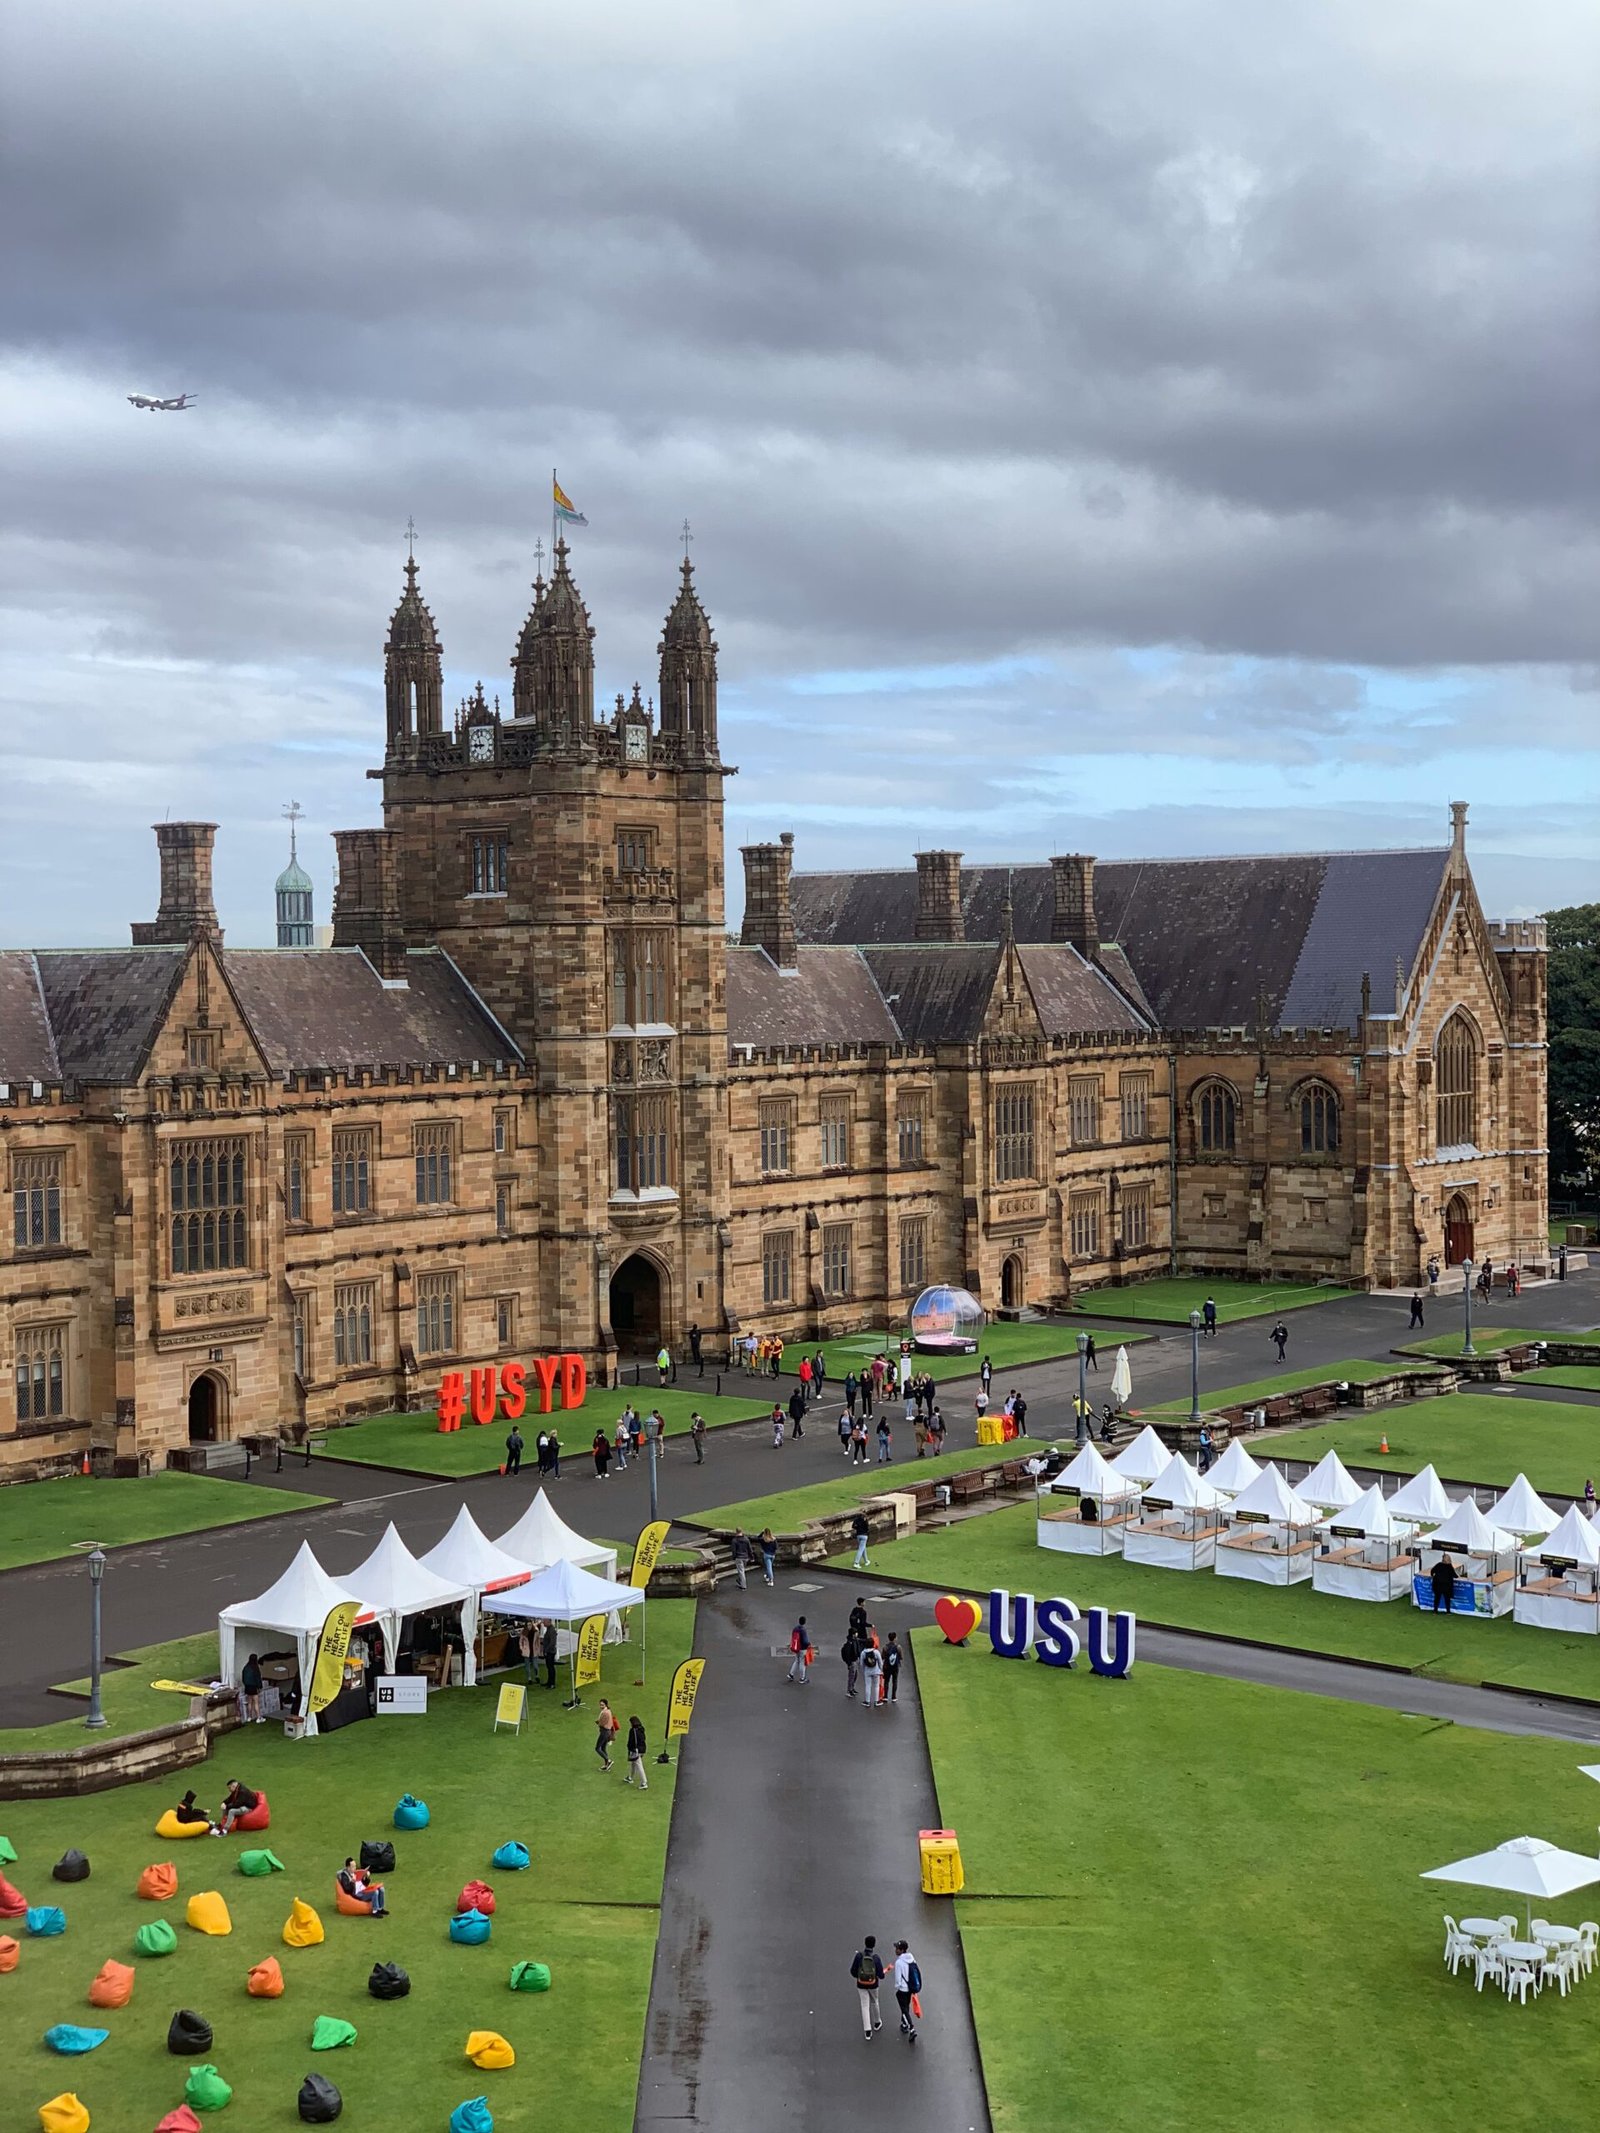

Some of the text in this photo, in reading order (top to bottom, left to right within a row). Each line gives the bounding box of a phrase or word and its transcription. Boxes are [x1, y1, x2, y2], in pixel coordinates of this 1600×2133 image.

[436, 1353, 587, 1432] #USYD
[641, 1531, 656, 1566] HEART OF
[646, 1555, 654, 1568] UNI
[324, 1636, 333, 1652] THE
[330, 1614, 345, 1656] HEART OF
[337, 1621, 350, 1658] UNI LIFE
[580, 1643, 588, 1659] THE
[586, 1624, 595, 1661] HEART OF
[989, 1589, 1136, 1678] USU
[675, 1689, 683, 1705] THE
[681, 1668, 692, 1706] HEART OF
[689, 1675, 697, 1692] LIFE
